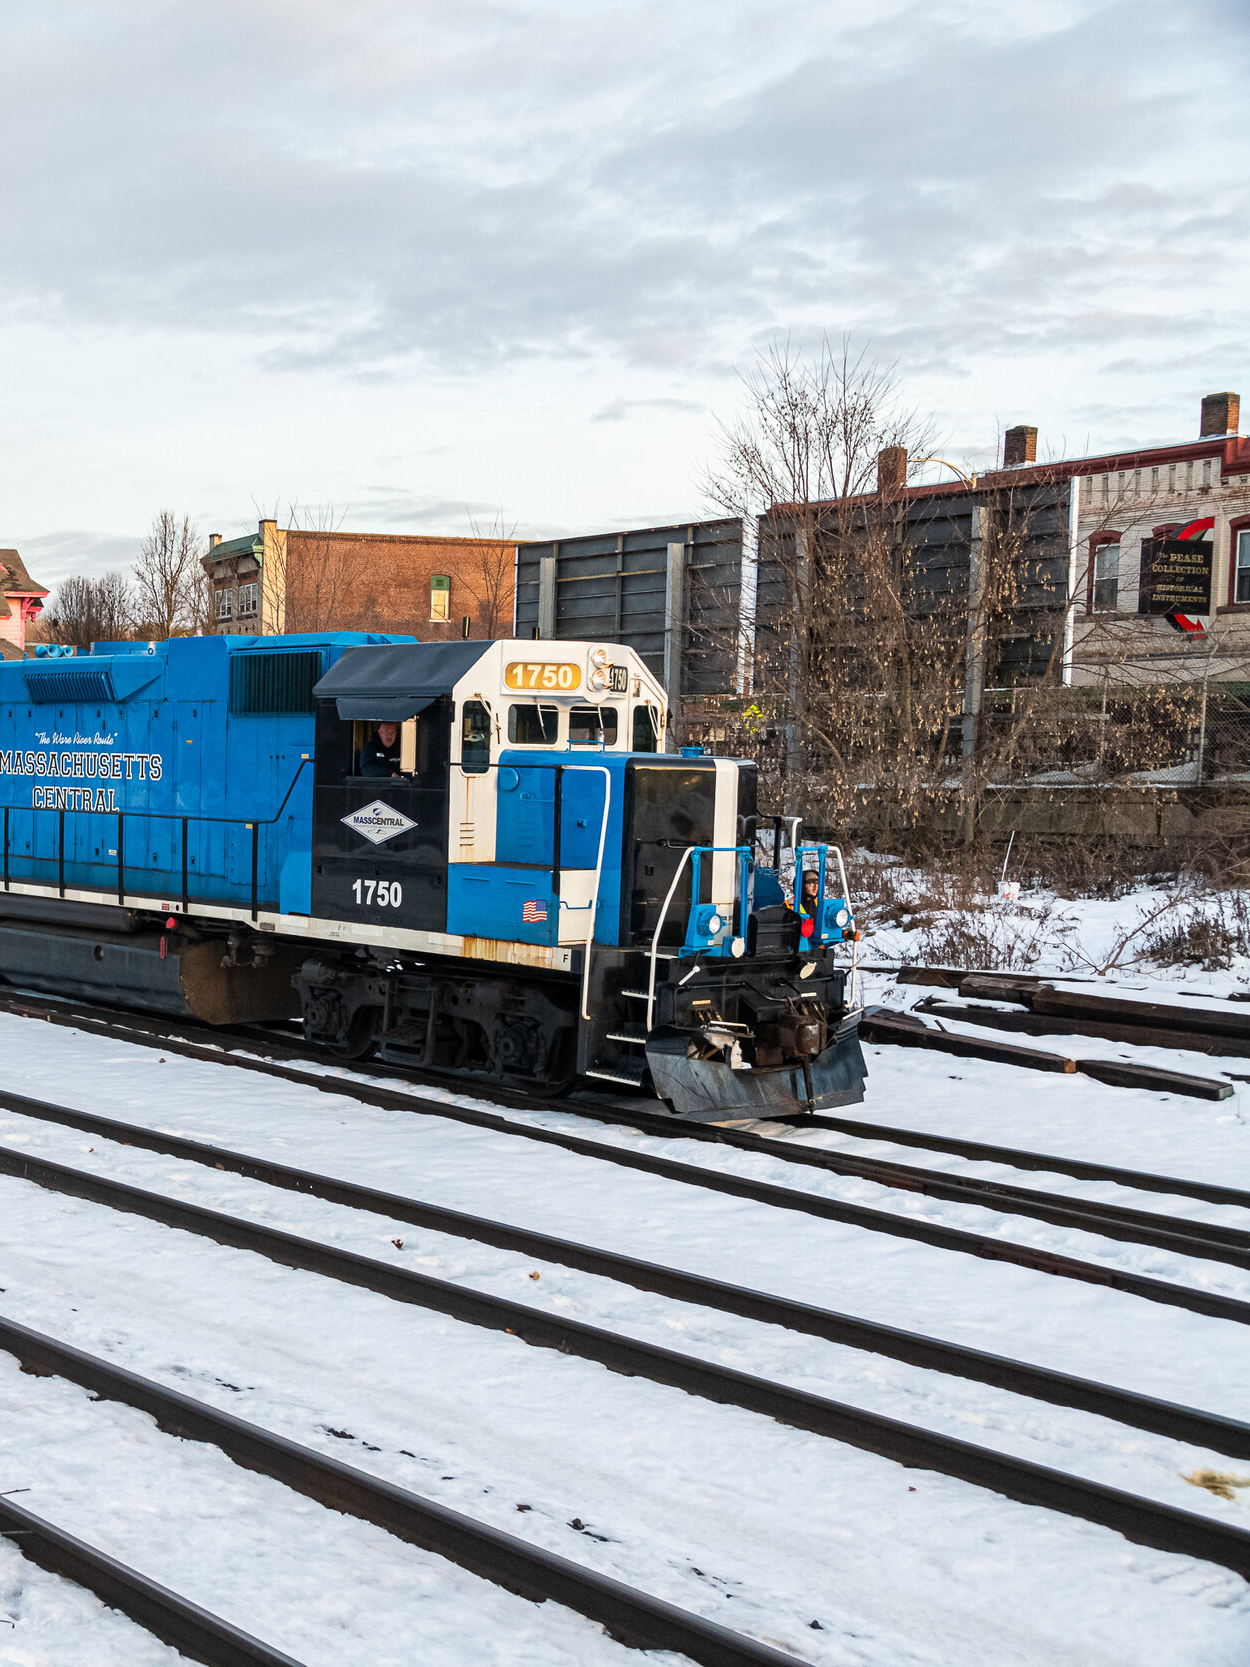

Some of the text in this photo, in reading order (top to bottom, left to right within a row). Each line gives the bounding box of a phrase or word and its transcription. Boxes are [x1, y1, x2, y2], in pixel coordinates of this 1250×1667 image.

[1170, 553, 1204, 563] PEASE
[1152, 564, 1209, 575] COLLECTION
[1157, 584, 1203, 593] HISTORICAL
[1152, 594, 1207, 603] INSTRUMENTS
[512, 664, 573, 688] 1750
[610, 667, 627, 690] 1750
[52, 731, 72, 745] Ware
[72, 731, 93, 745] River
[32, 785, 120, 813] CENTRAL
[353, 816, 404, 827] MASSCENTRAL
[352, 879, 402, 908] 1750
[562, 953, 569, 963] F
